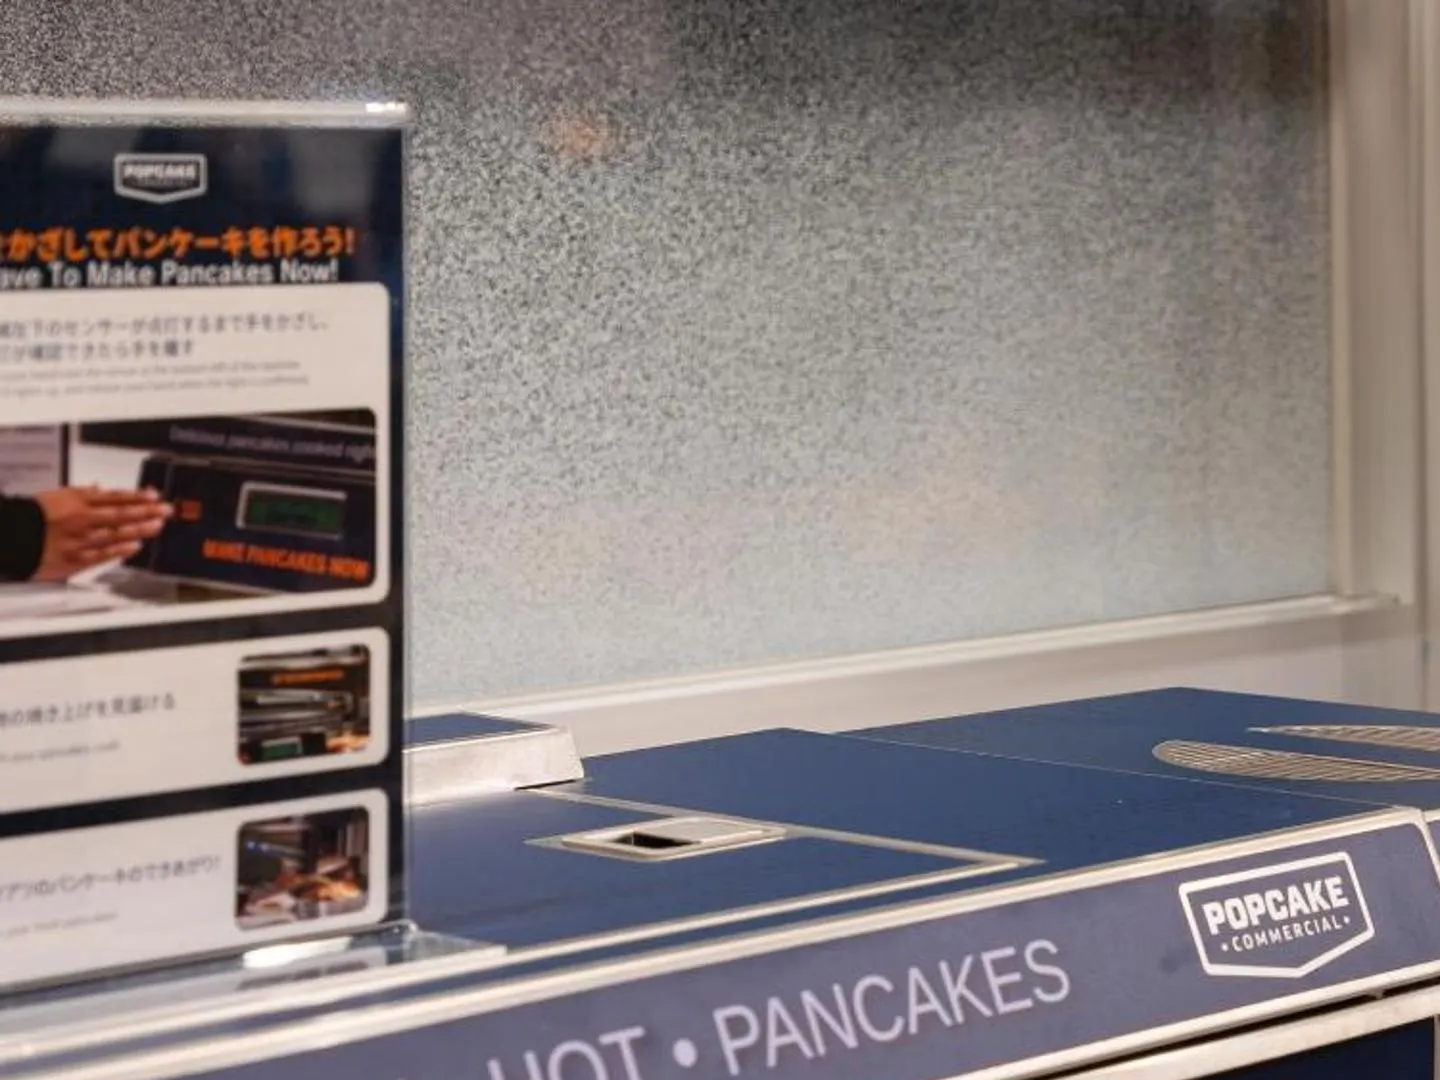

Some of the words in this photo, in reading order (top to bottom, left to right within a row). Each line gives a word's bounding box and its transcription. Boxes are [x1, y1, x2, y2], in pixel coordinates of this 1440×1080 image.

[51, 260, 82, 286] To
[87, 260, 155, 287] Make
[161, 256, 274, 285] Pancakes
[279, 255, 339, 282] Now!
[247, 544, 327, 575] PANCAKES
[1202, 876, 1349, 935] POPCAKE
[1231, 917, 1342, 953] COMMERCIAL
[712, 938, 1072, 1077] PANCAKES
